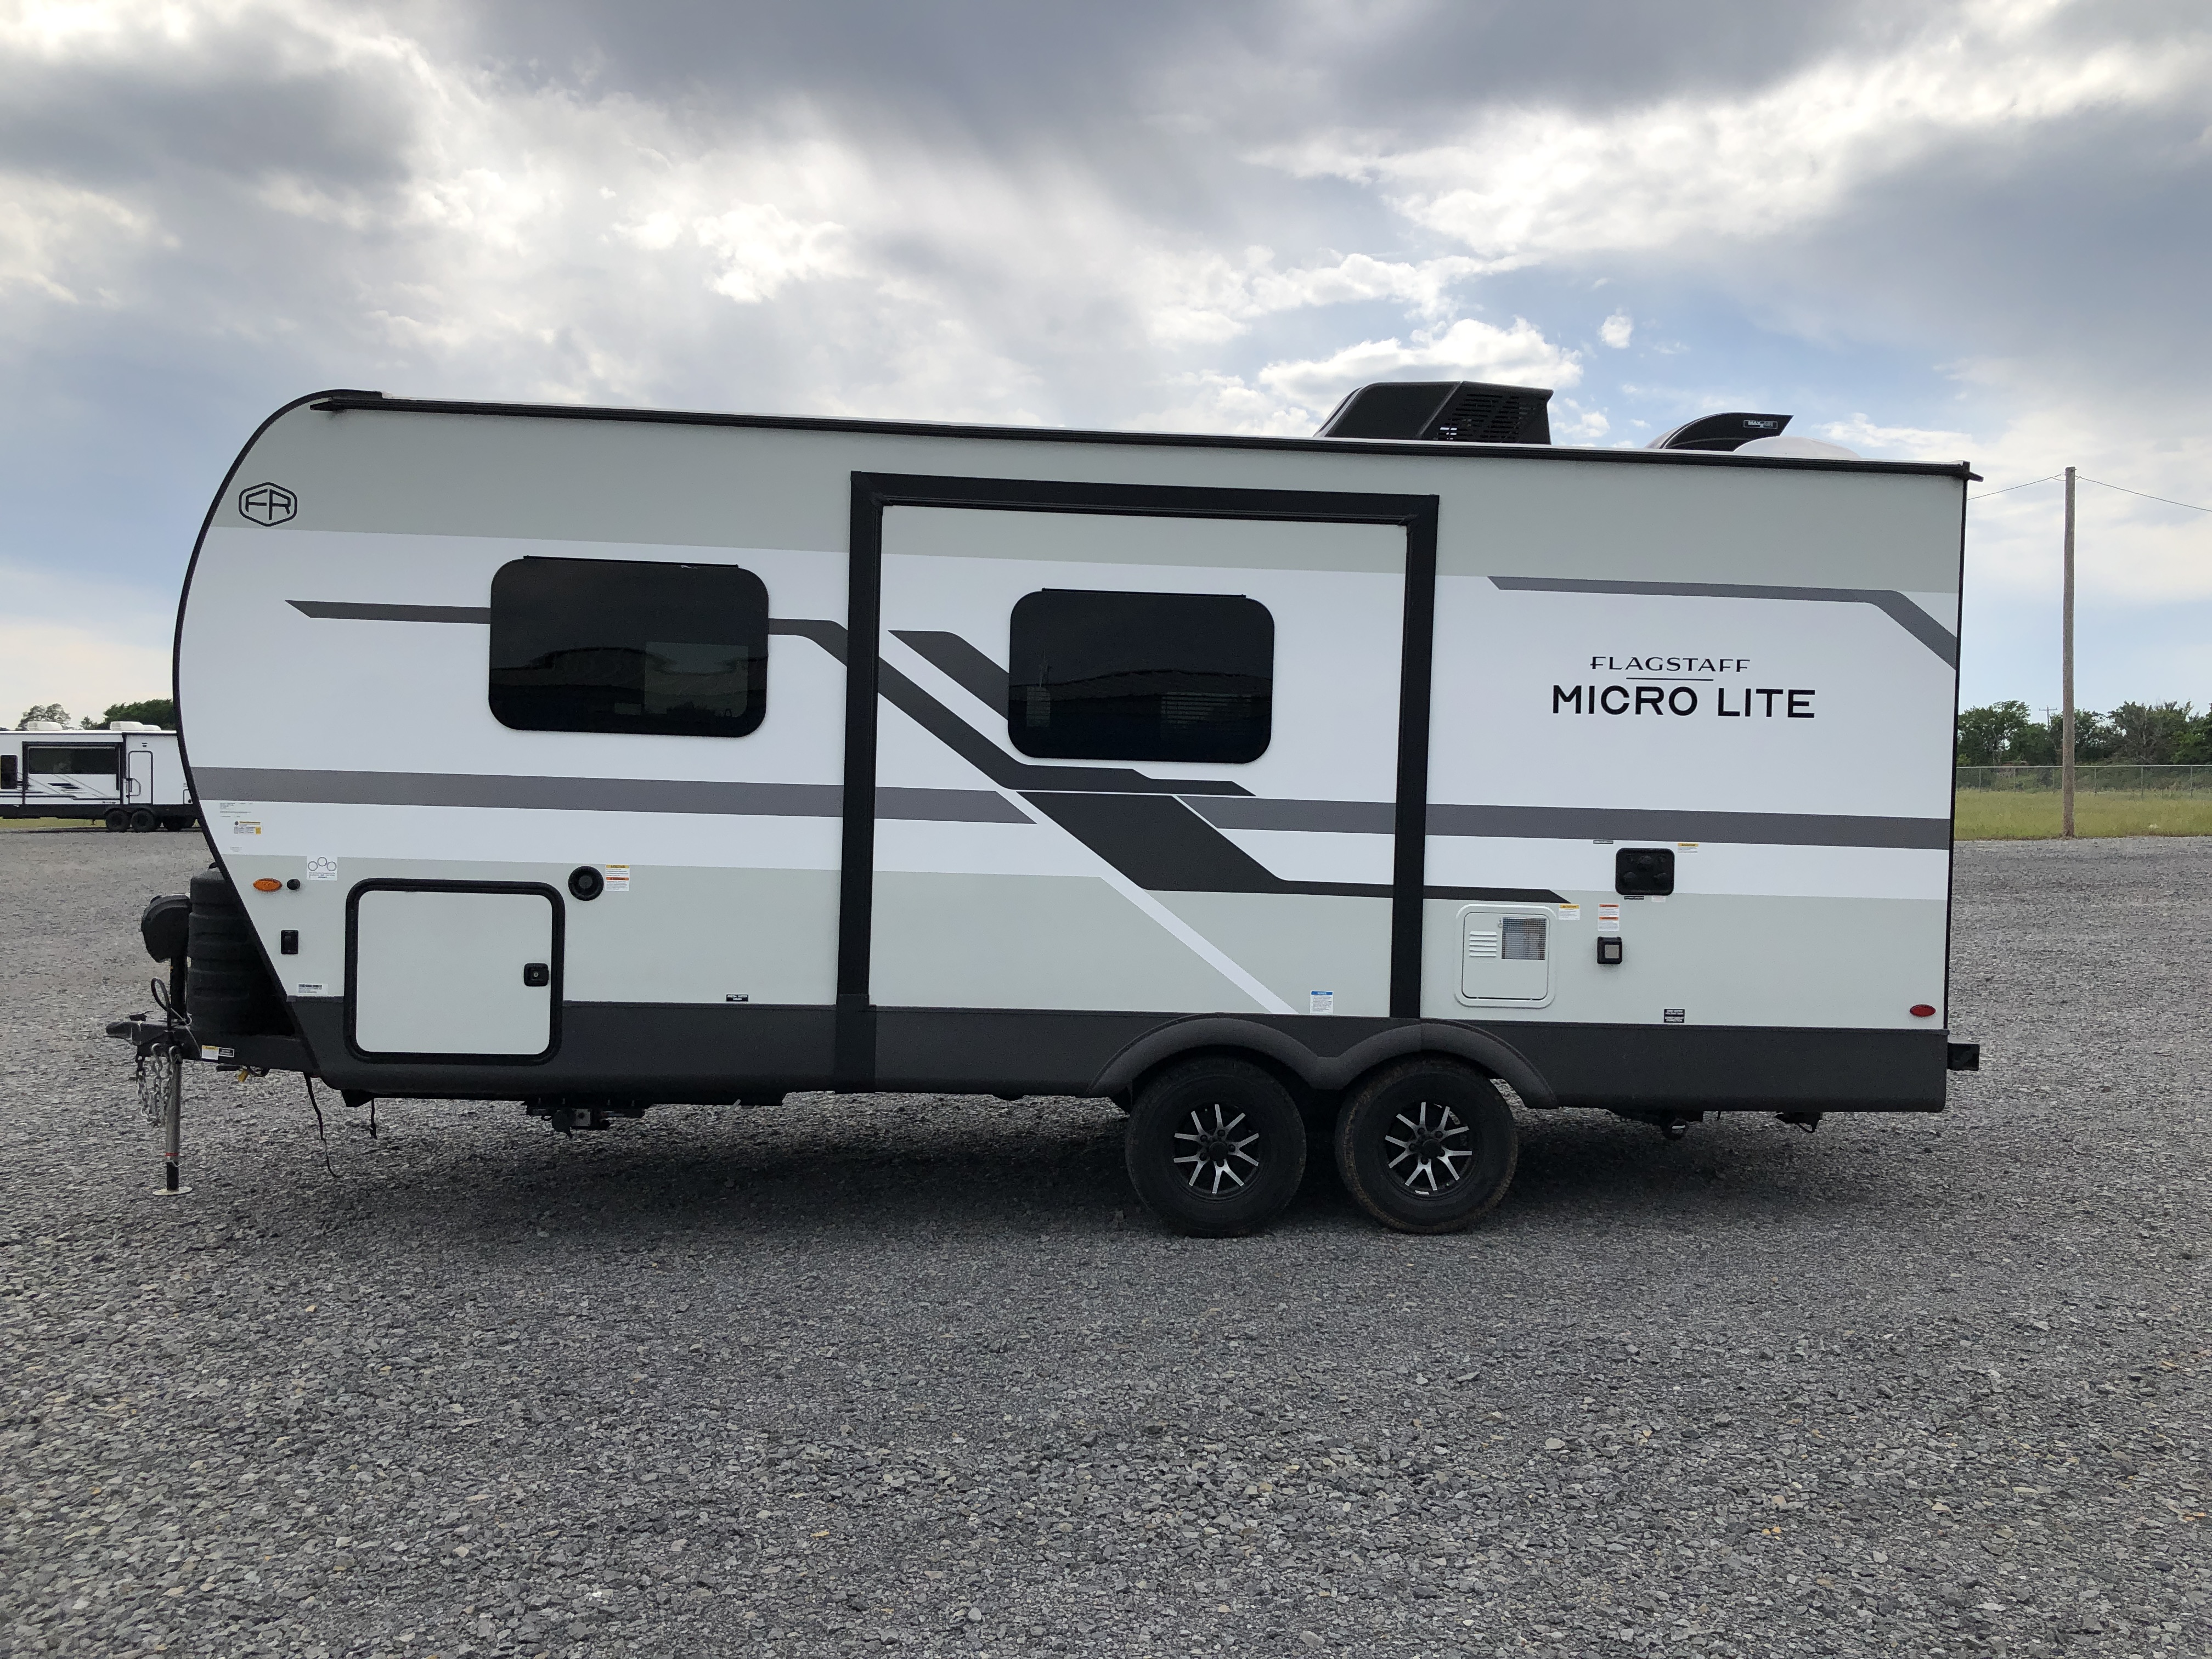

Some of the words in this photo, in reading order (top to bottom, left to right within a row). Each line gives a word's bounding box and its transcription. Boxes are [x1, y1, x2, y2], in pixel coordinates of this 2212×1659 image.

[245, 488, 291, 521] FR
[1590, 656, 1751, 673] FLAGSTAFF
[1553, 685, 1698, 716] MICRO
[1717, 688, 1815, 718] LITE
